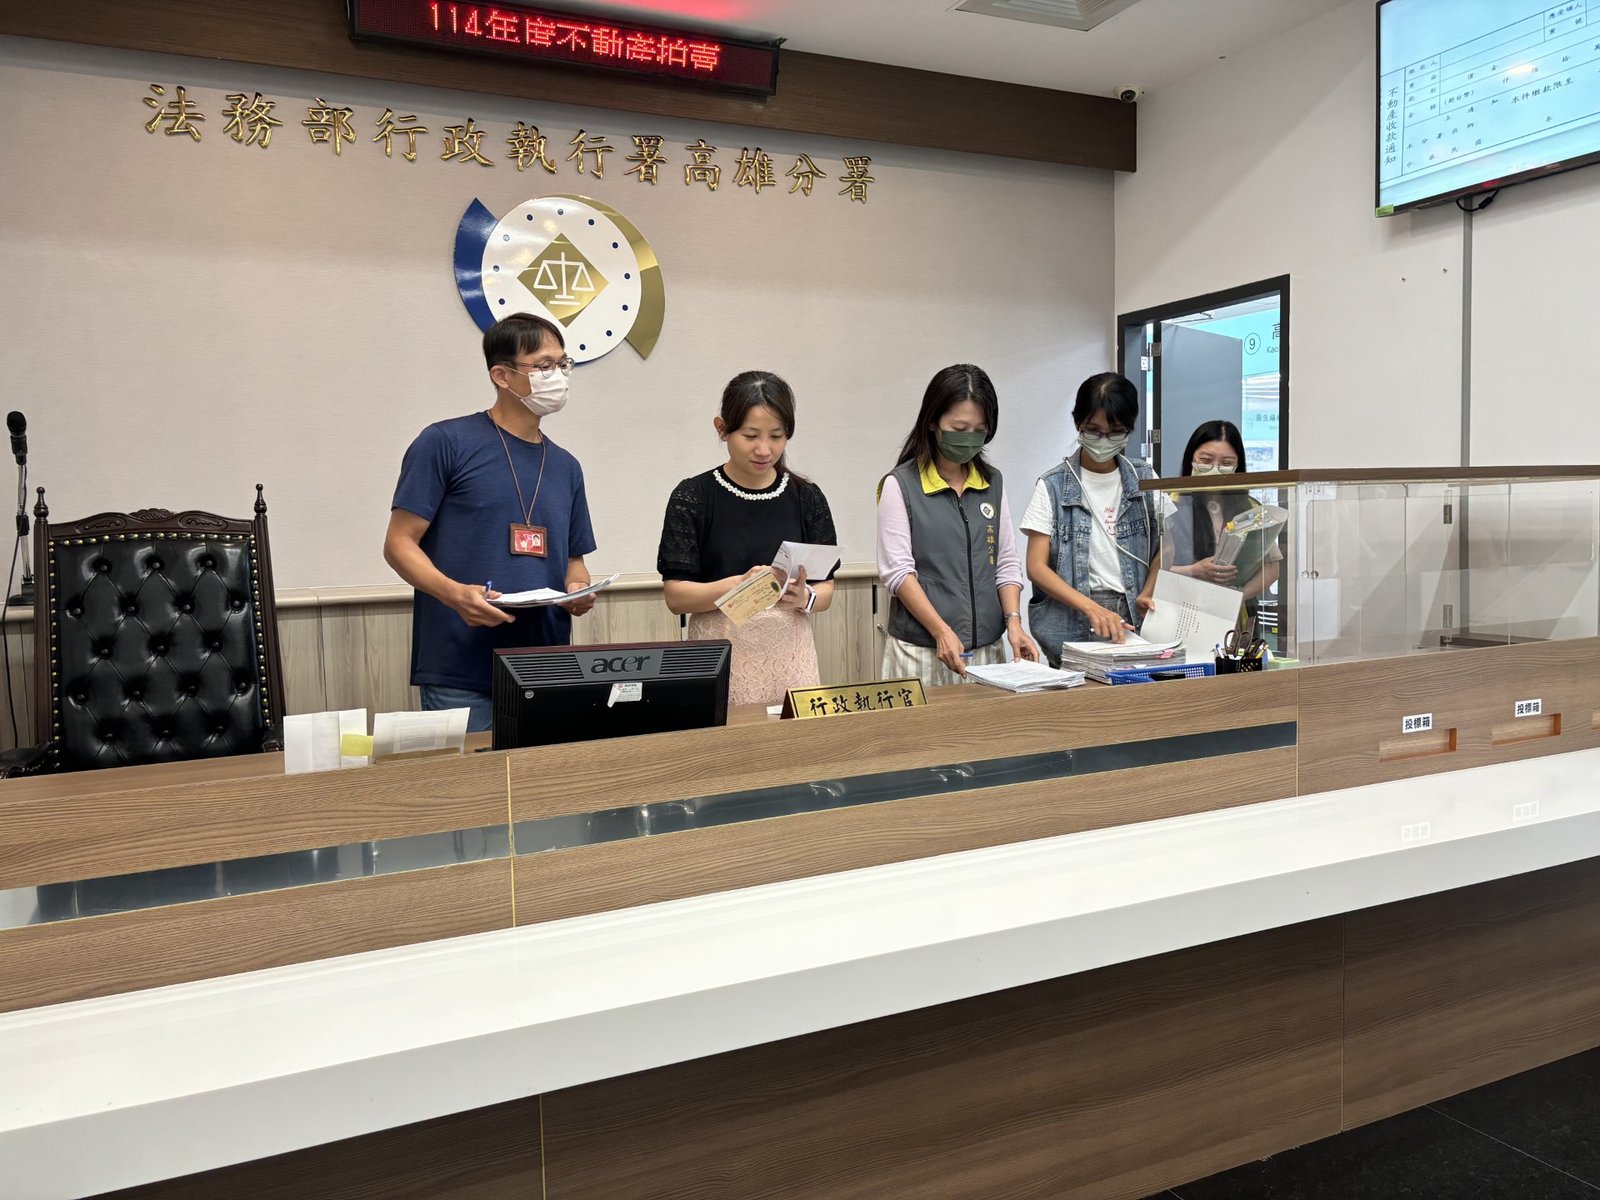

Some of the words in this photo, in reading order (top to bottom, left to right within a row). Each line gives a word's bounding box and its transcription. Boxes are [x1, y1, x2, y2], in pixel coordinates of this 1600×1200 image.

[1384, 86, 1399, 167] 不動產收款通知
[143, 83, 875, 204] 法務部行政執行署高雄分署
[590, 655, 650, 674] acer
[809, 687, 915, 716] 行政執行官
[1516, 702, 1540, 715] 投標箱
[1404, 716, 1431, 731] 投標箱
